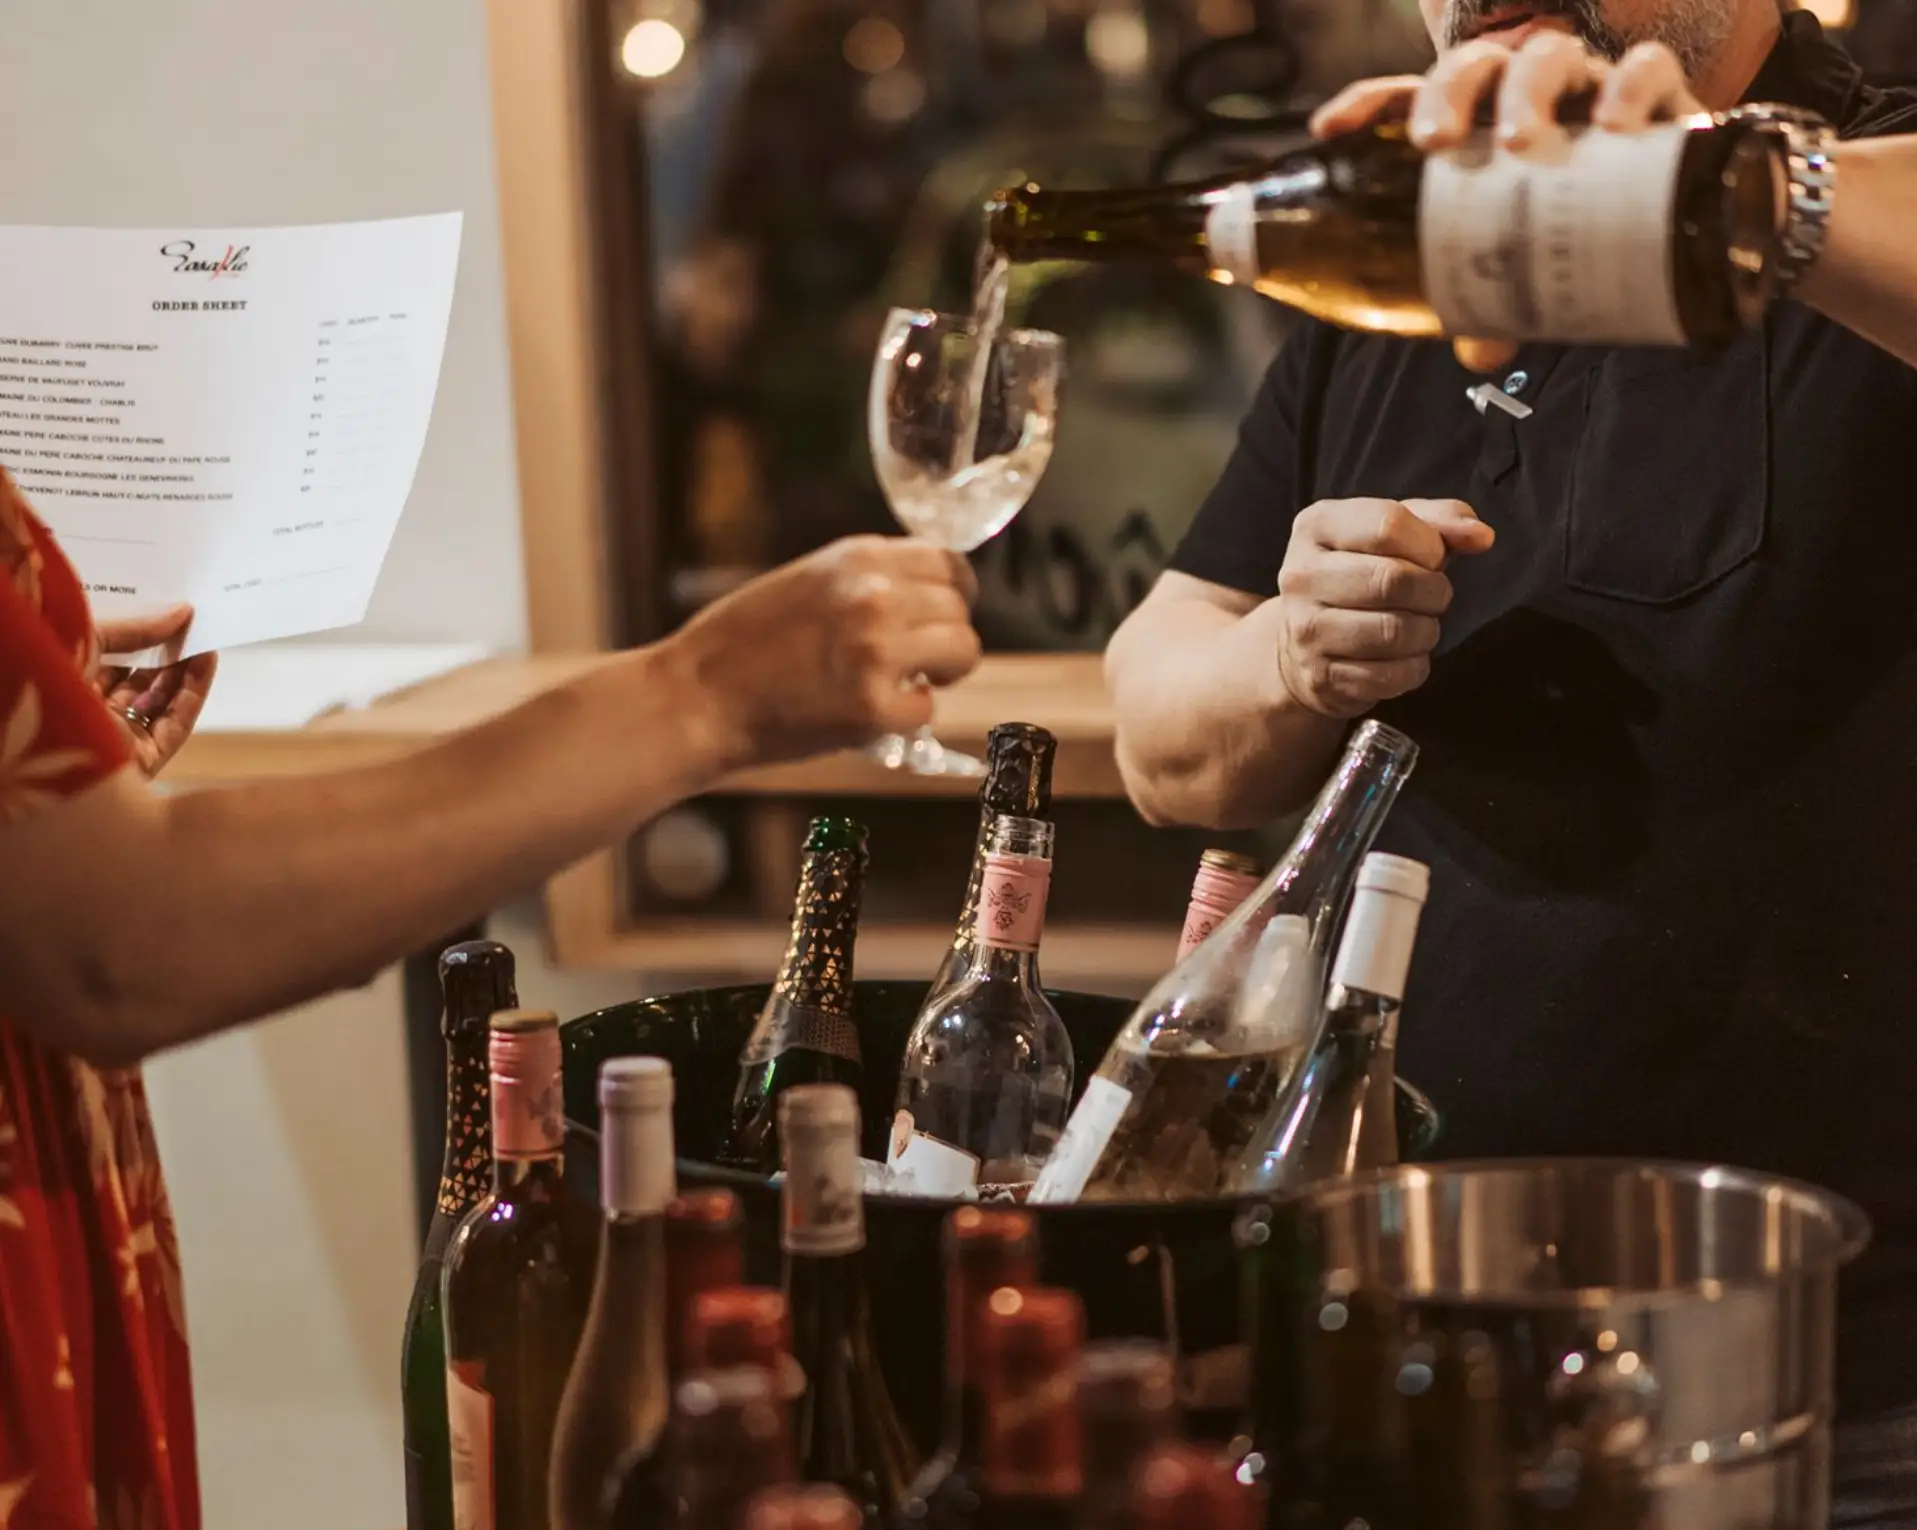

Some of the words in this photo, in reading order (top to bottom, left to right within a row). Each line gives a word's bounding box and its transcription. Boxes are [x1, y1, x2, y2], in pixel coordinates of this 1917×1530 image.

[152, 300, 199, 311] ORDER
[202, 300, 248, 311] SHEET
[28, 376, 39, 384] DE
[27, 394, 40, 402] DU
[93, 583, 107, 592] OR
[109, 585, 136, 595] MORE
